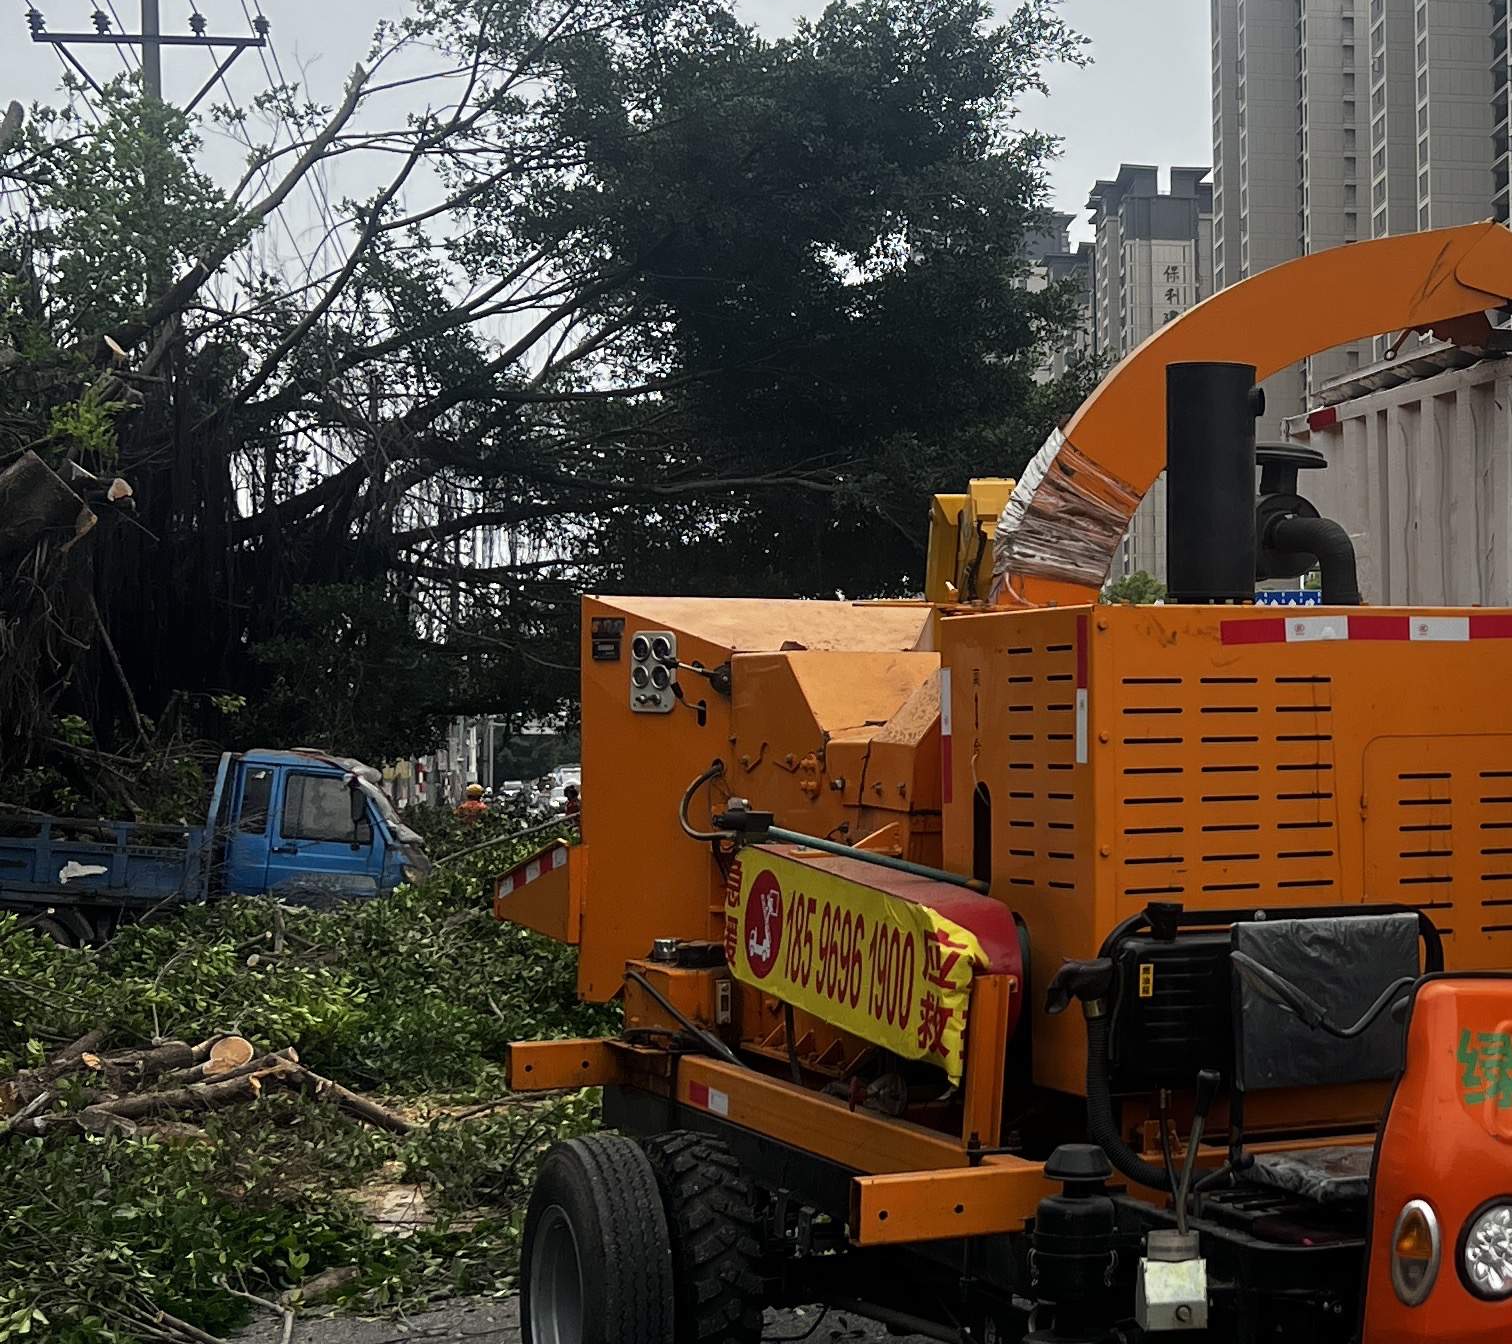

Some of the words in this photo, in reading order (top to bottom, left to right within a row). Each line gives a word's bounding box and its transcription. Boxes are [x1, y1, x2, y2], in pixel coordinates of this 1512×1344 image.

[785, 890, 817, 988] 185
[816, 901, 864, 1009] 9696
[868, 920, 915, 1030] 1900
[923, 928, 970, 990] 应
[917, 990, 968, 1059] 救
